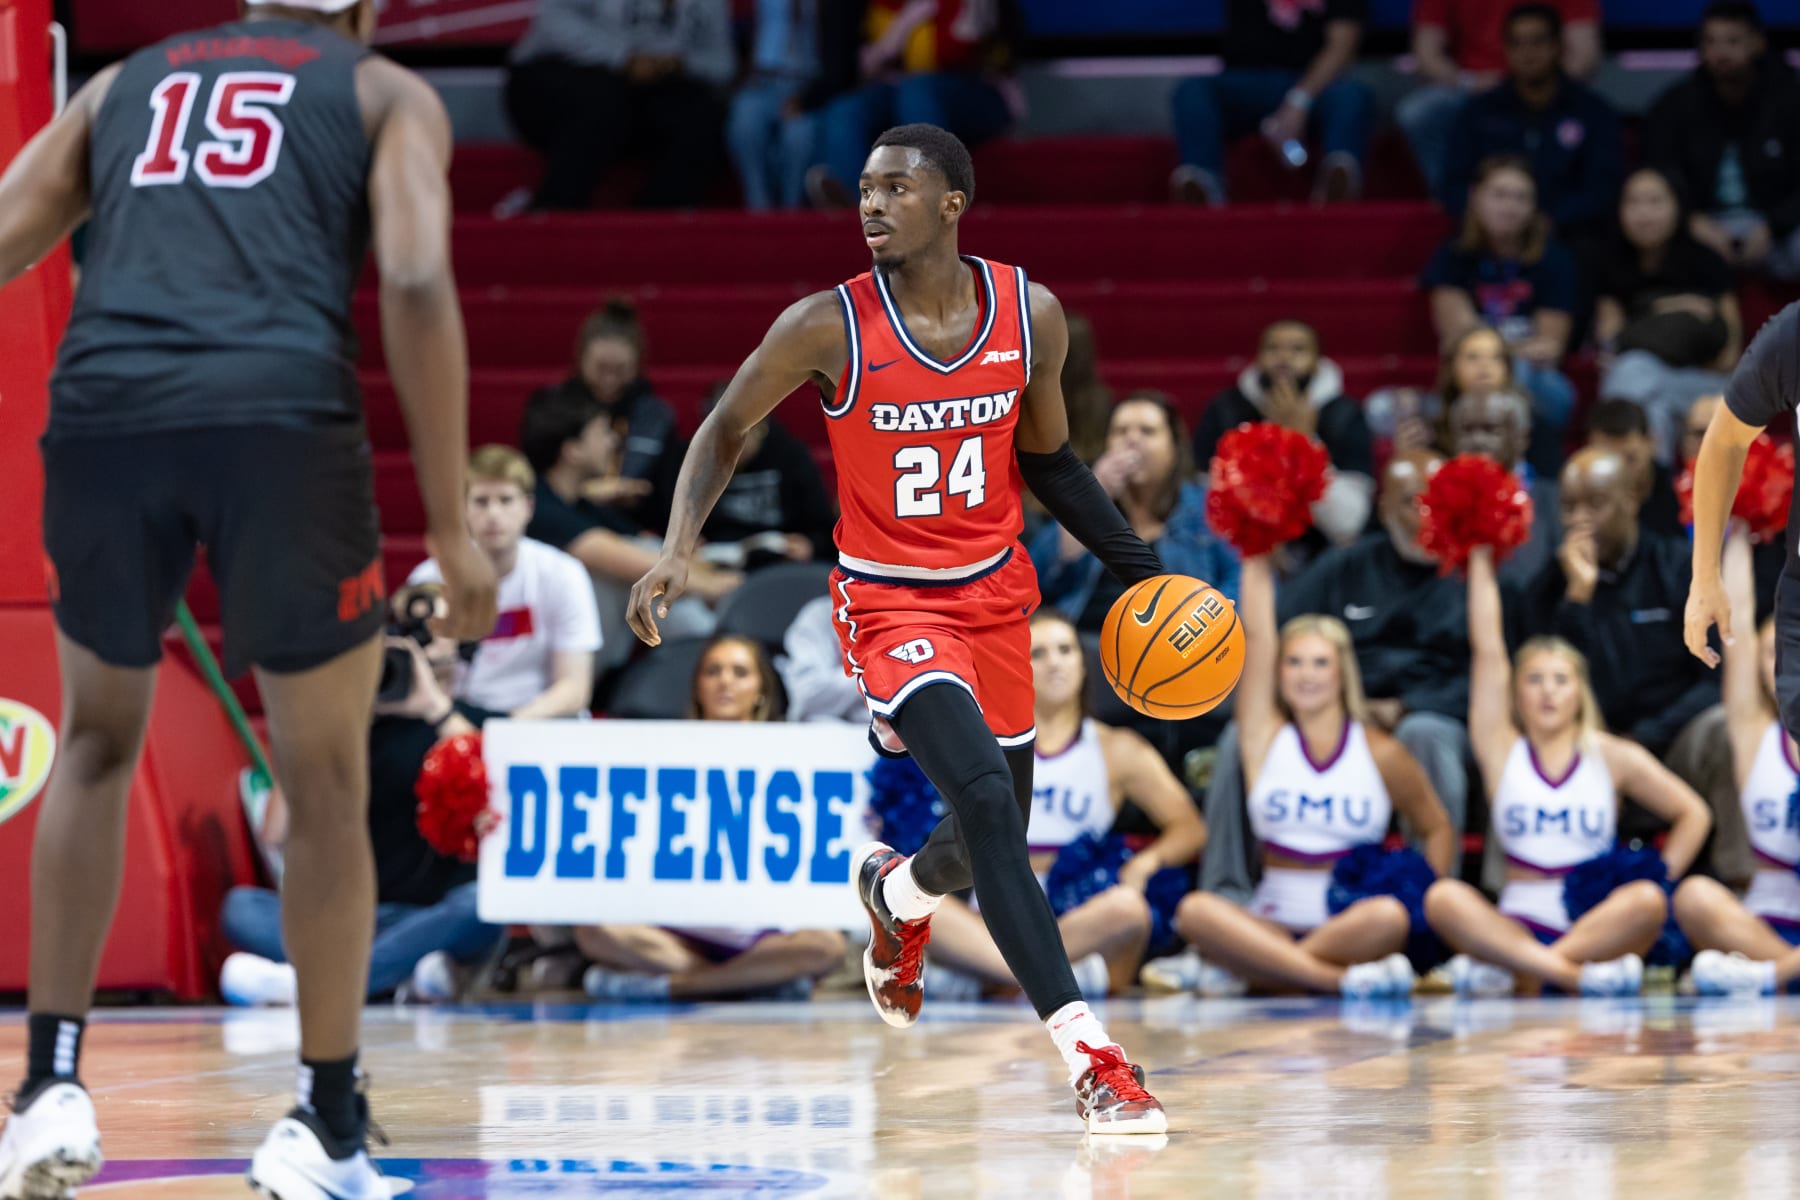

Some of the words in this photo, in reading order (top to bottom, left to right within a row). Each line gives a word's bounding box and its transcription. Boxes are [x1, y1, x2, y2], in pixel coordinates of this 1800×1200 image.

[130, 72, 296, 187] 15
[980, 350, 1020, 366] A10
[868, 388, 1019, 432] DAYTON
[893, 434, 986, 519] 24
[1167, 594, 1225, 653] ELITE
[504, 765, 853, 884] DEFENSE
[1033, 786, 1093, 822] MU
[1264, 789, 1370, 828] SMU
[1504, 803, 1605, 838] SMU
